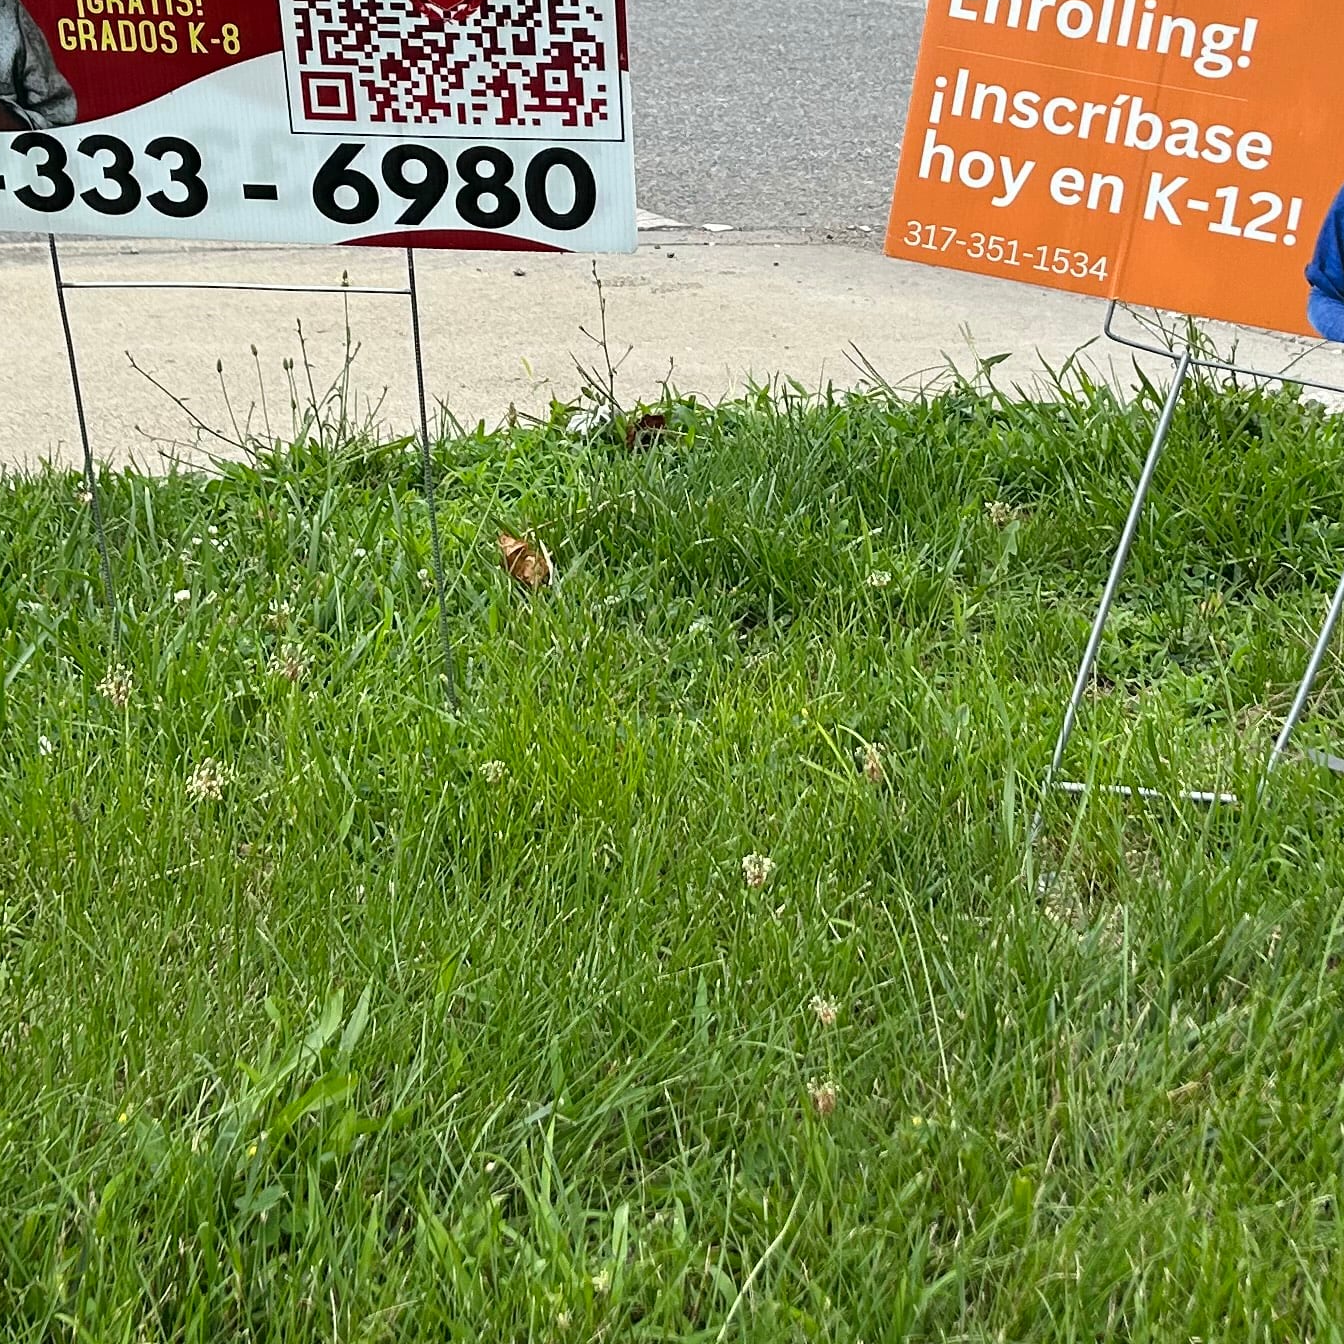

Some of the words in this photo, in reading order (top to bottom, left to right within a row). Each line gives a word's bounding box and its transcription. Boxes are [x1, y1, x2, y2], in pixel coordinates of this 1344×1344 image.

[58, 18, 178, 54] GRADOS
[188, 22, 241, 55] K-8
[928, 68, 1274, 171] ¡Inscríbase
[312, 142, 597, 230] 6980
[918, 129, 1035, 208] hoy
[1050, 165, 1125, 214] en
[1143, 172, 1303, 247] K-12!
[903, 220, 1109, 282] 317-351-1534
